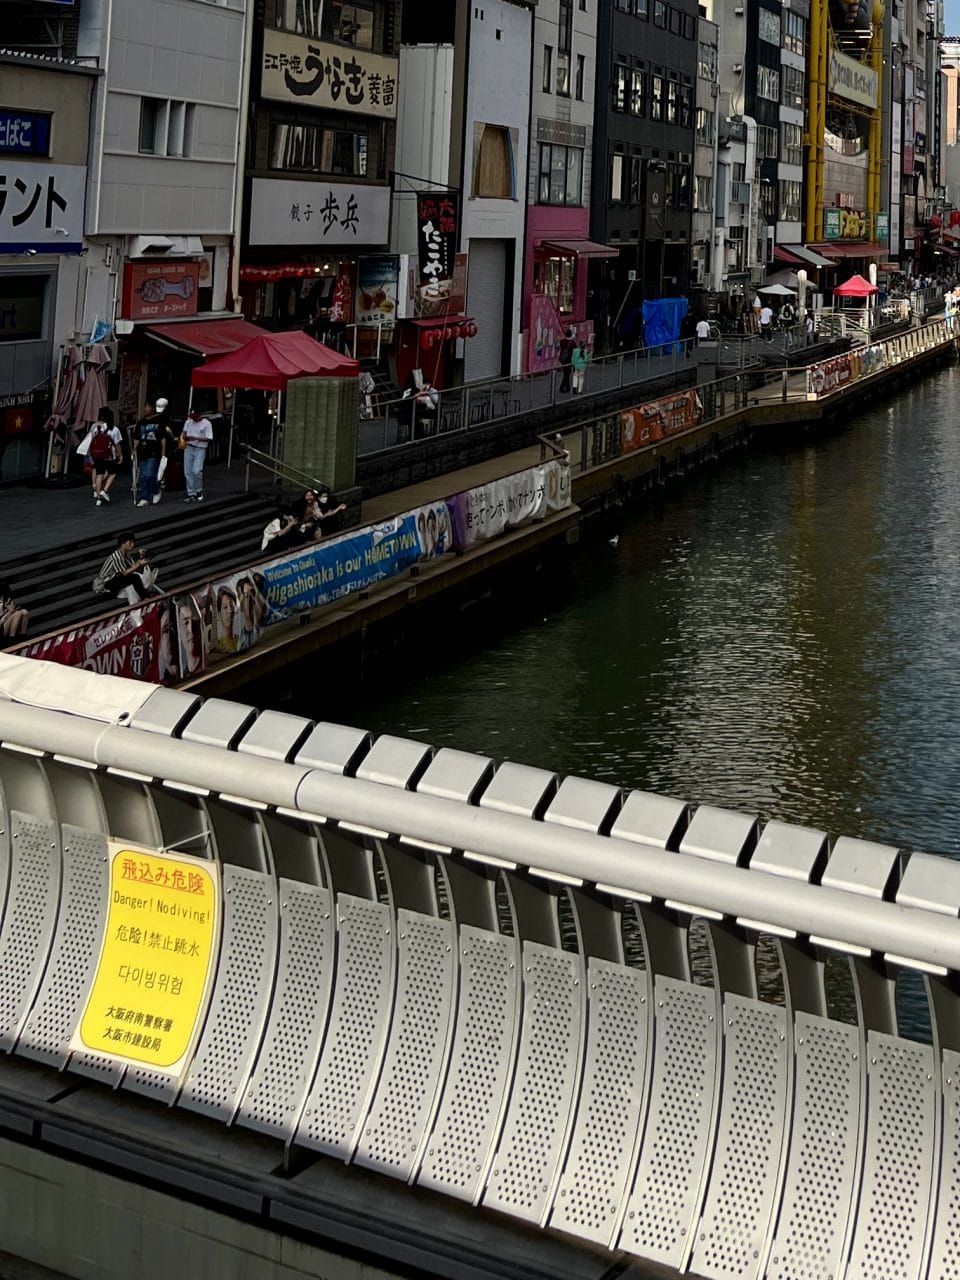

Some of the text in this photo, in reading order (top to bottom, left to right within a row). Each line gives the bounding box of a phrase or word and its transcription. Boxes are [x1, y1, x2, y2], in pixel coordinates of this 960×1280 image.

[285, 45, 367, 105] うなぎ
[0, 176, 67, 229] ント
[345, 556, 361, 574] our
[121, 858, 206, 895] 飛込み危険
[113, 889, 153, 912] Danger!
[105, 1006, 173, 1032] 大阪府南警察署
[103, 1027, 161, 1051] 大阪市建設局
